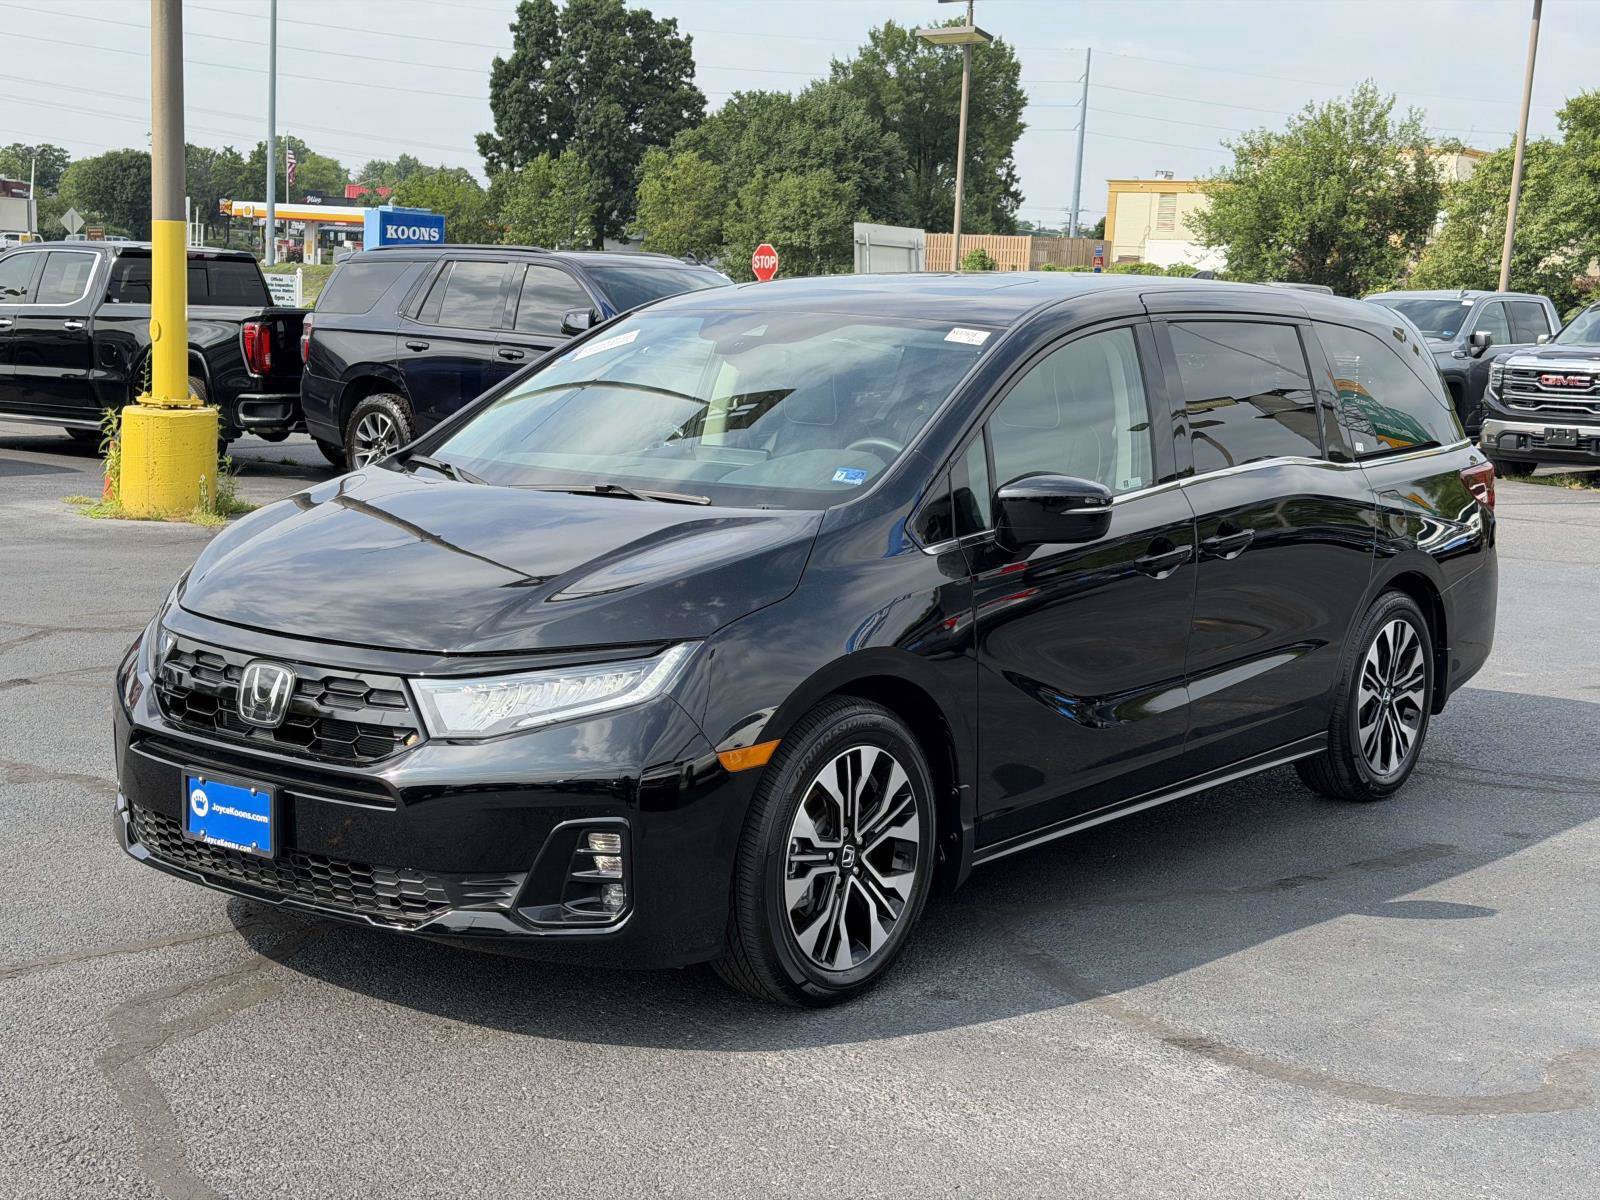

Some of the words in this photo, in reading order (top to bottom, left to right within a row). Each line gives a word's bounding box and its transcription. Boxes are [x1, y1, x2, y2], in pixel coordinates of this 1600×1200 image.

[386, 224, 440, 241] KOONS
[754, 255, 776, 269] STOP
[1540, 374, 1591, 387] GMC
[211, 802, 269, 823] JoyceKoons.com
[203, 835, 252, 853] JoyceKoons.com
